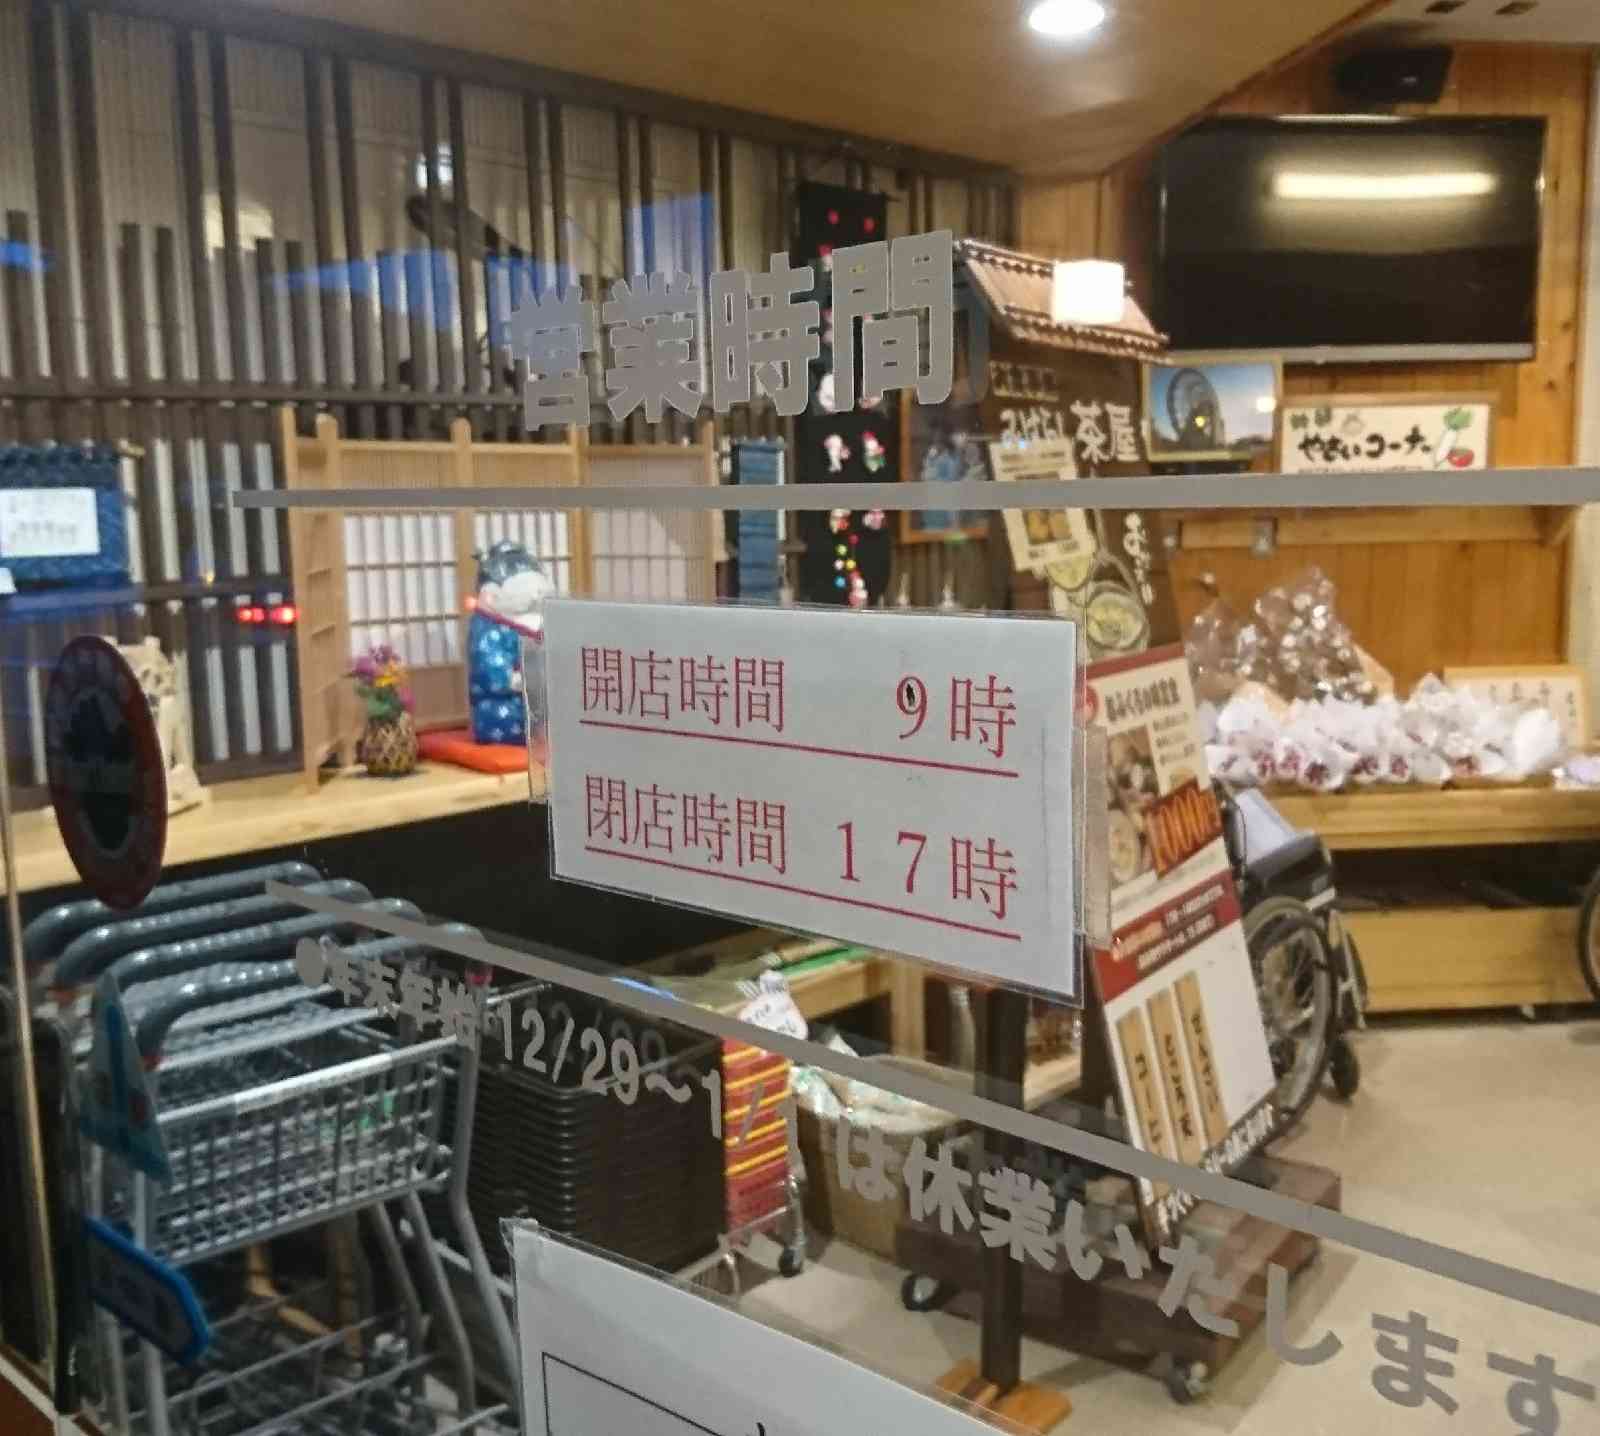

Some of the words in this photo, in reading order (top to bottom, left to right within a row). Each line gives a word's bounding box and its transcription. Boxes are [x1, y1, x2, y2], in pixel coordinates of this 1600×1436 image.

[510, 229, 954, 432] 営業時間
[580, 646, 785, 733] 開店時間
[895, 674, 1017, 759] 9時
[585, 773, 787, 876] 閉店時間
[836, 820, 1019, 921] 17時
